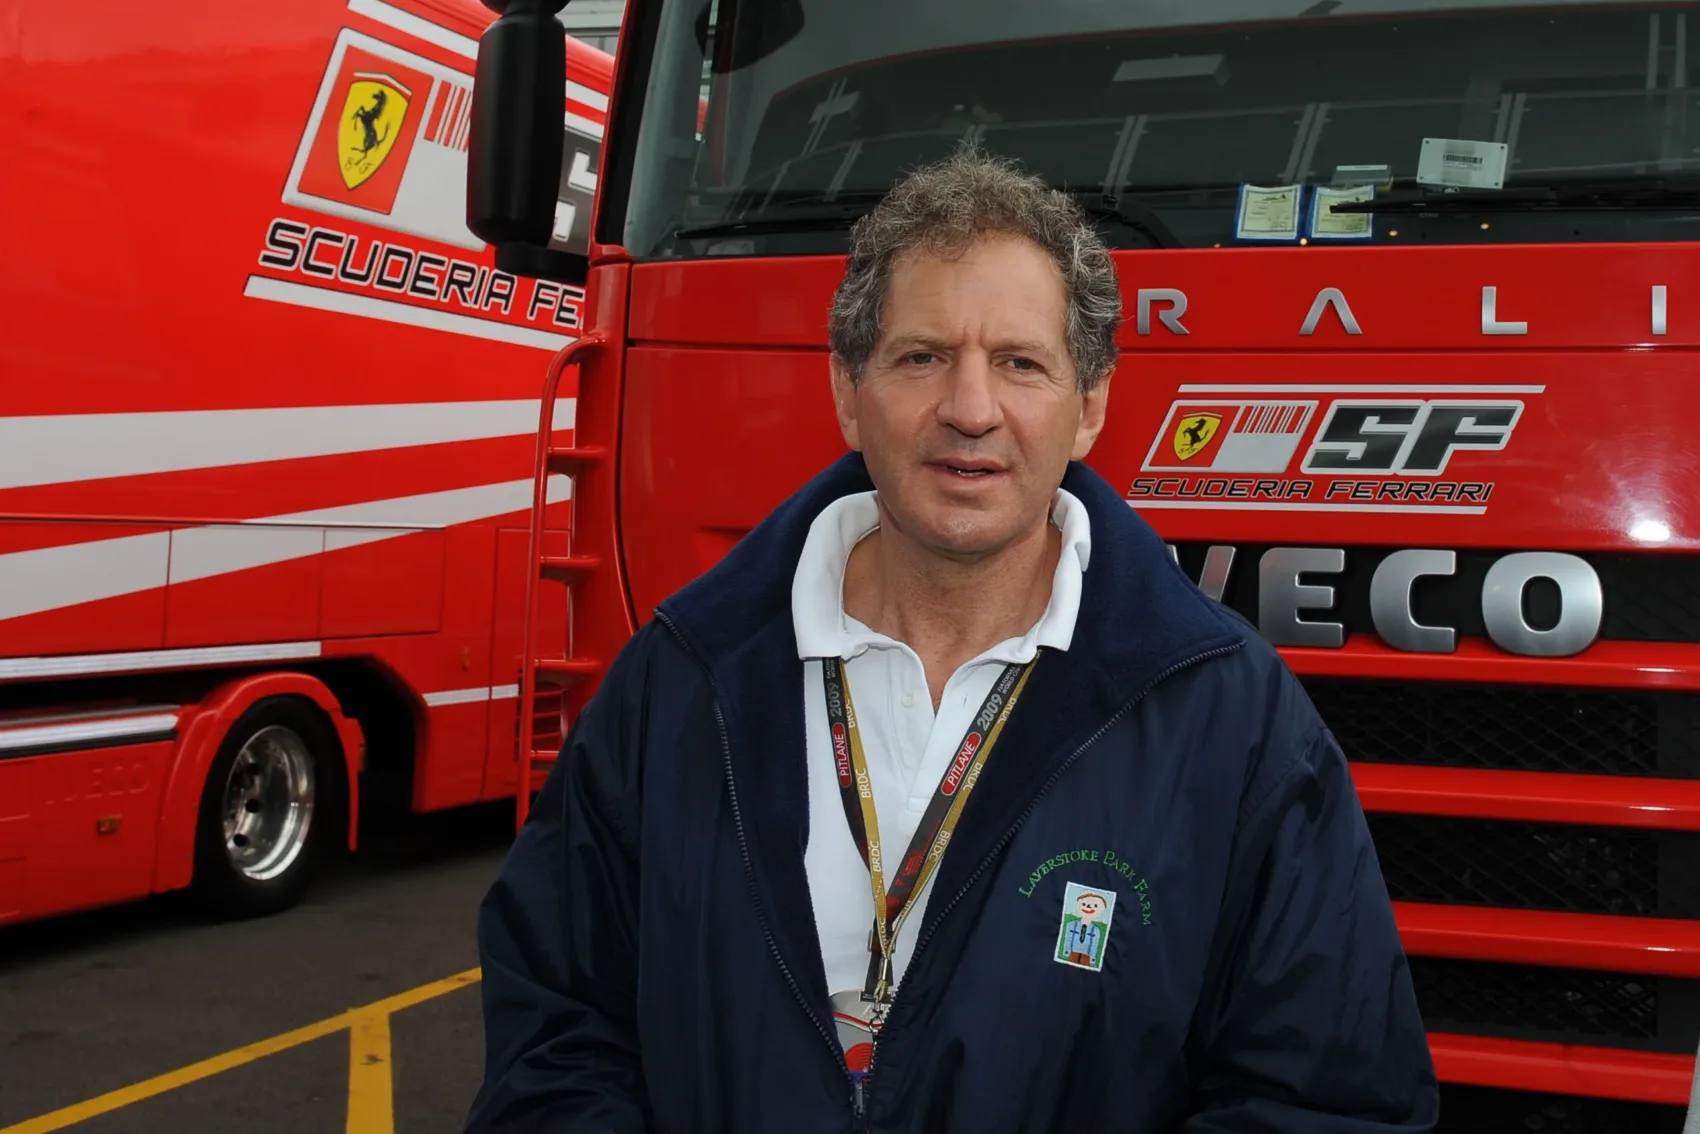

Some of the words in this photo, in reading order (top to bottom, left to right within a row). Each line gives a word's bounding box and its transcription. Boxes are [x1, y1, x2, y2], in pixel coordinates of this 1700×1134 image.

[258, 217, 517, 314] SCUDERIA
[526, 278, 586, 330] FE
[1301, 399, 1524, 476] SF
[1128, 477, 1315, 499] SCUDERIA
[1325, 480, 1495, 503] FERRARI
[827, 682, 842, 717] 2009
[976, 693, 1002, 731] 2009
[835, 734, 849, 776] PITLANE
[947, 741, 975, 787] PITLANE
[855, 767, 872, 798] BRDC
[870, 840, 881, 873] BRDC
[929, 830, 951, 862] BRDC
[1018, 849, 1098, 898] LAVERSTOKE
[1103, 850, 1136, 880] PARK
[1134, 878, 1151, 925] FARM
